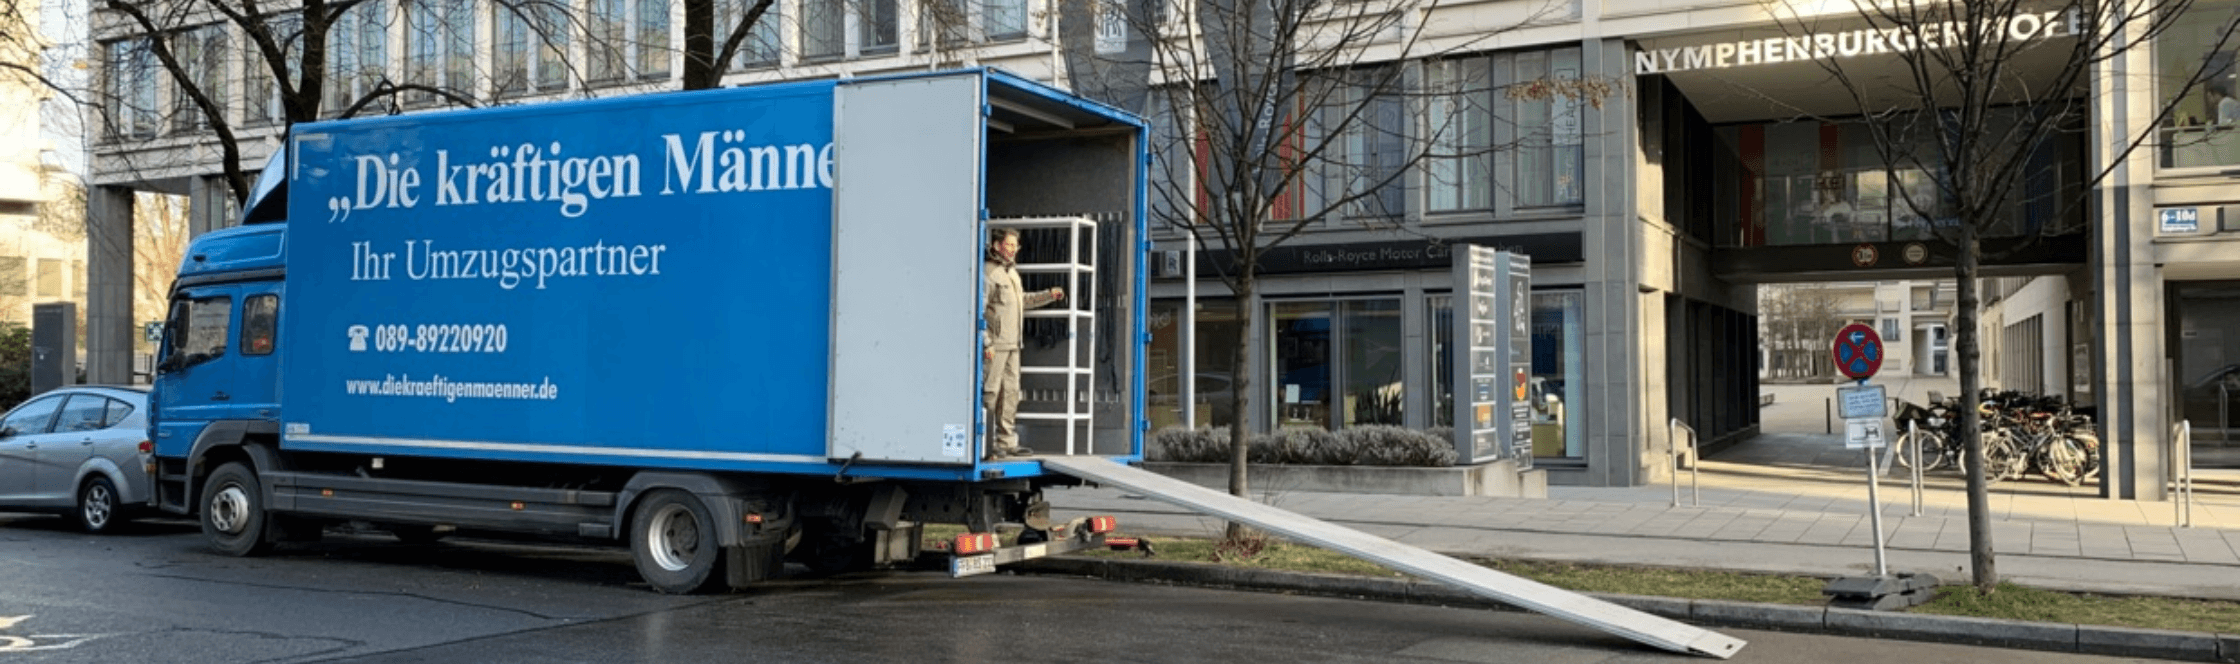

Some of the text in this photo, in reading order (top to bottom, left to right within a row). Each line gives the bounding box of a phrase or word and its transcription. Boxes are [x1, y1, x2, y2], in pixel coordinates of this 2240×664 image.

[1634, 21, 1970, 76] NYMPHENBURGER
[435, 141, 642, 218] kräftigen
[659, 128, 834, 196] Männe
[350, 239, 667, 290] Ihr Umzugspartner
[1379, 246, 1421, 261] Motor
[1425, 244, 1451, 260] Car
[374, 323, 508, 353] 089-89220920
[345, 372, 558, 404] www.diekraeftigenmaenner.de
